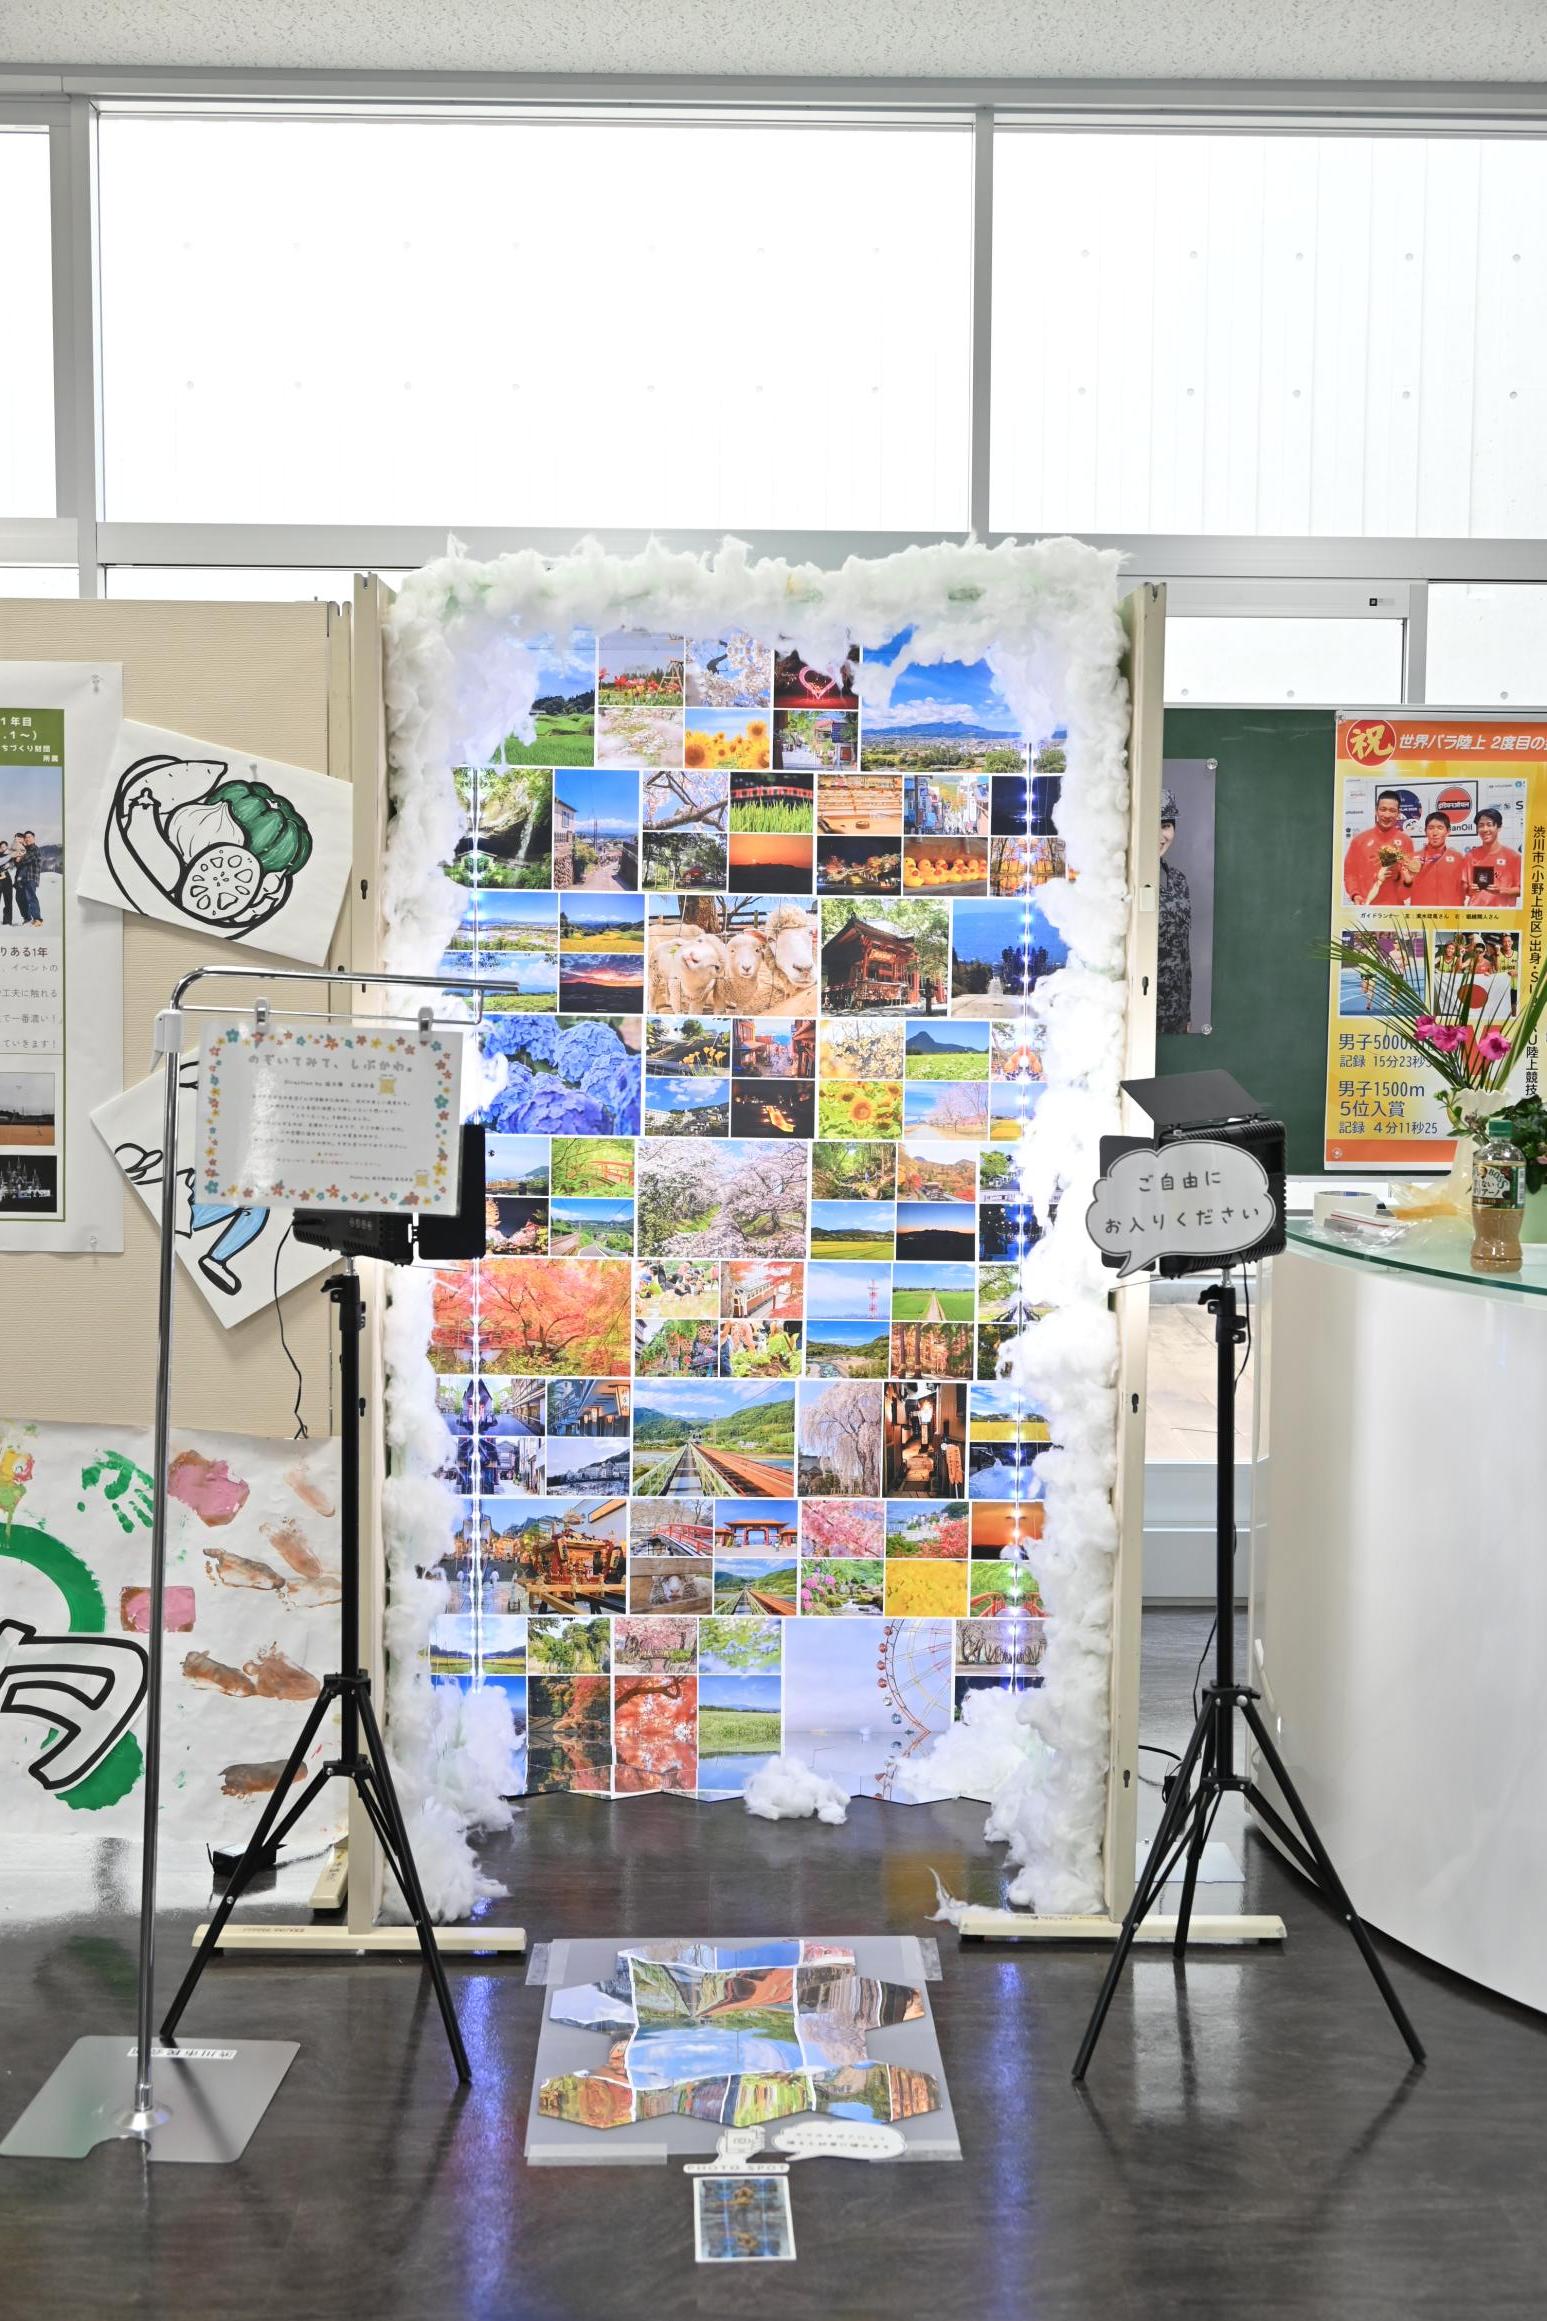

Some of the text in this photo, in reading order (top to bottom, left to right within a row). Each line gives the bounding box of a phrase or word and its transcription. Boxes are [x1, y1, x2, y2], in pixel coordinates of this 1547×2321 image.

[1350, 724, 1394, 760] 祝
[1448, 824, 1473, 832] anOil
[0, 988, 58, 998] 工夫に触れる
[1339, 1033, 1425, 1050] 男子5000
[1339, 1055, 1365, 1067] 記録
[1338, 1080, 1425, 1097] 男子1500m
[1340, 1101, 1405, 1117] 5位入賞
[1338, 1122, 1365, 1134] 記録
[1139, 1171, 1222, 1192] ご自由に
[1488, 1168, 1509, 1189] BOSS
[1105, 1207, 1259, 1234] お入りください
